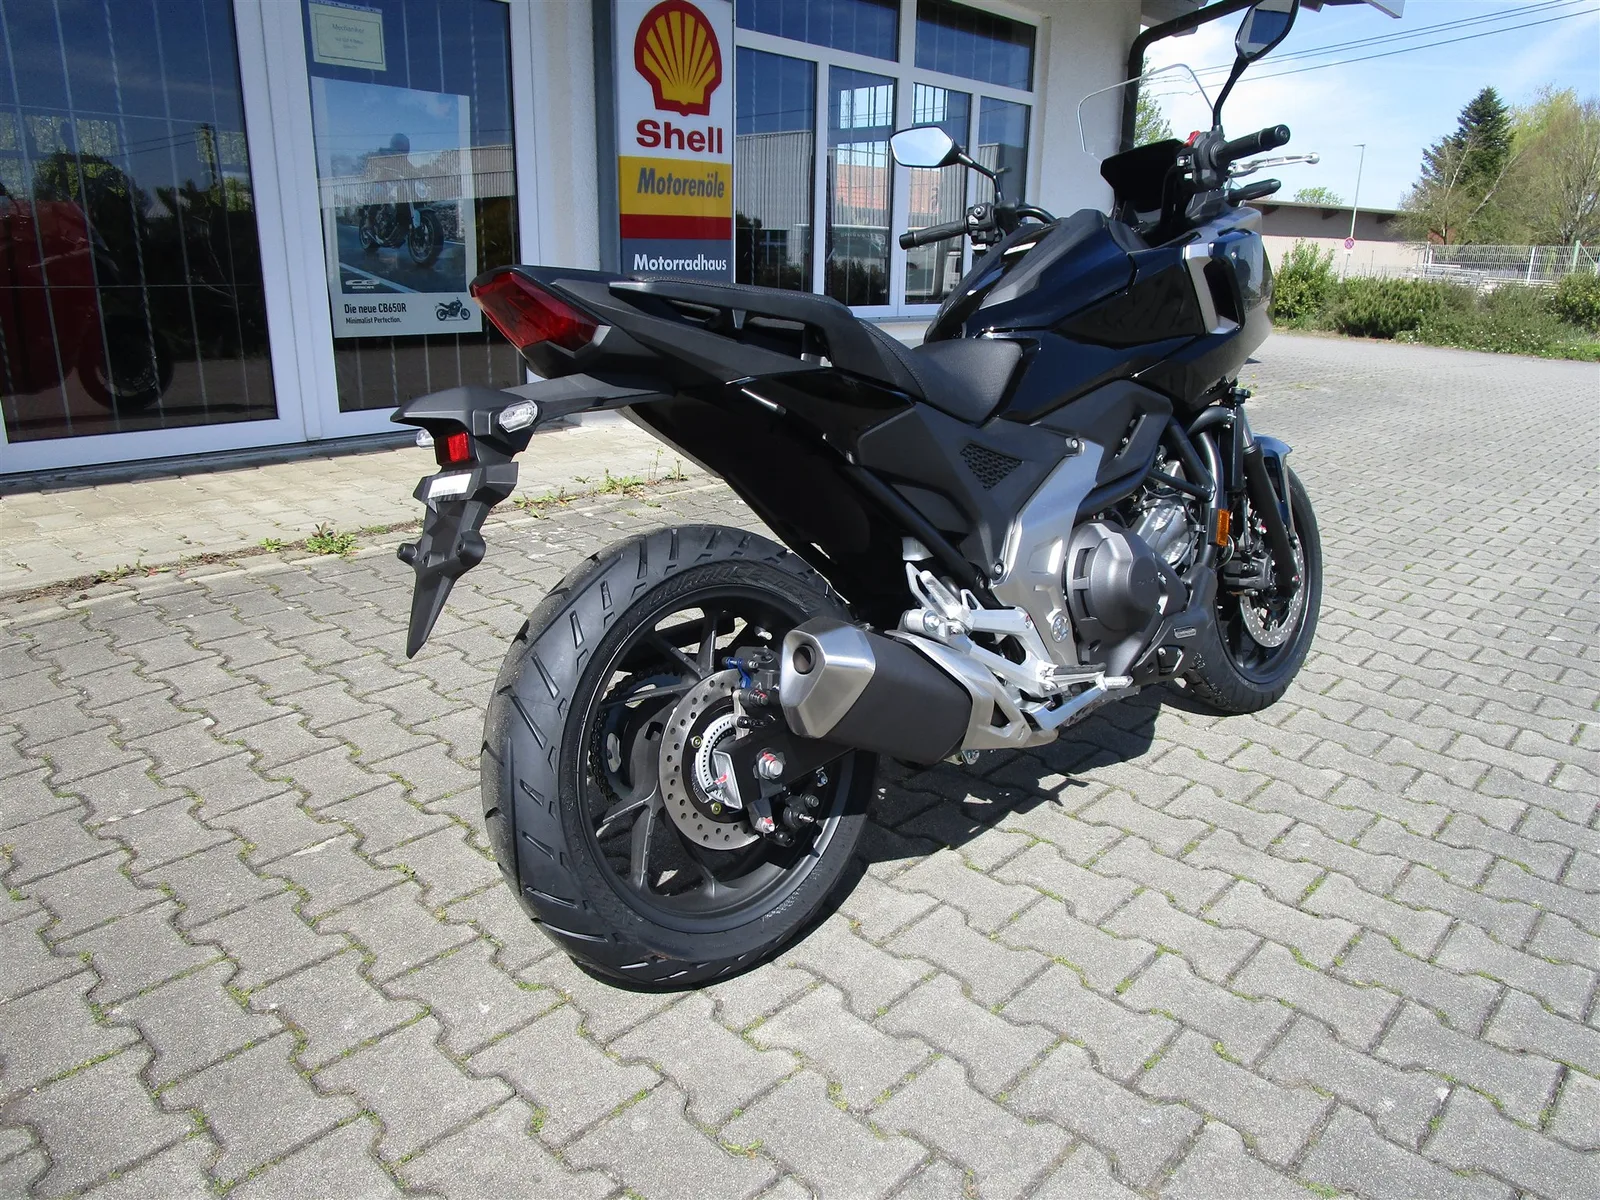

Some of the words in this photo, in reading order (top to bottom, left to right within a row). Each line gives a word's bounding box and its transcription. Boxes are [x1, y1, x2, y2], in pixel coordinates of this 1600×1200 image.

[636, 119, 723, 154] Shell
[637, 167, 725, 198] Motorenöle
[633, 254, 727, 271] Motorradhaus
[344, 303, 357, 314] Die
[358, 304, 377, 314] neue
[378, 302, 407, 313] CB650R
[345, 316, 373, 324] Minimalist
